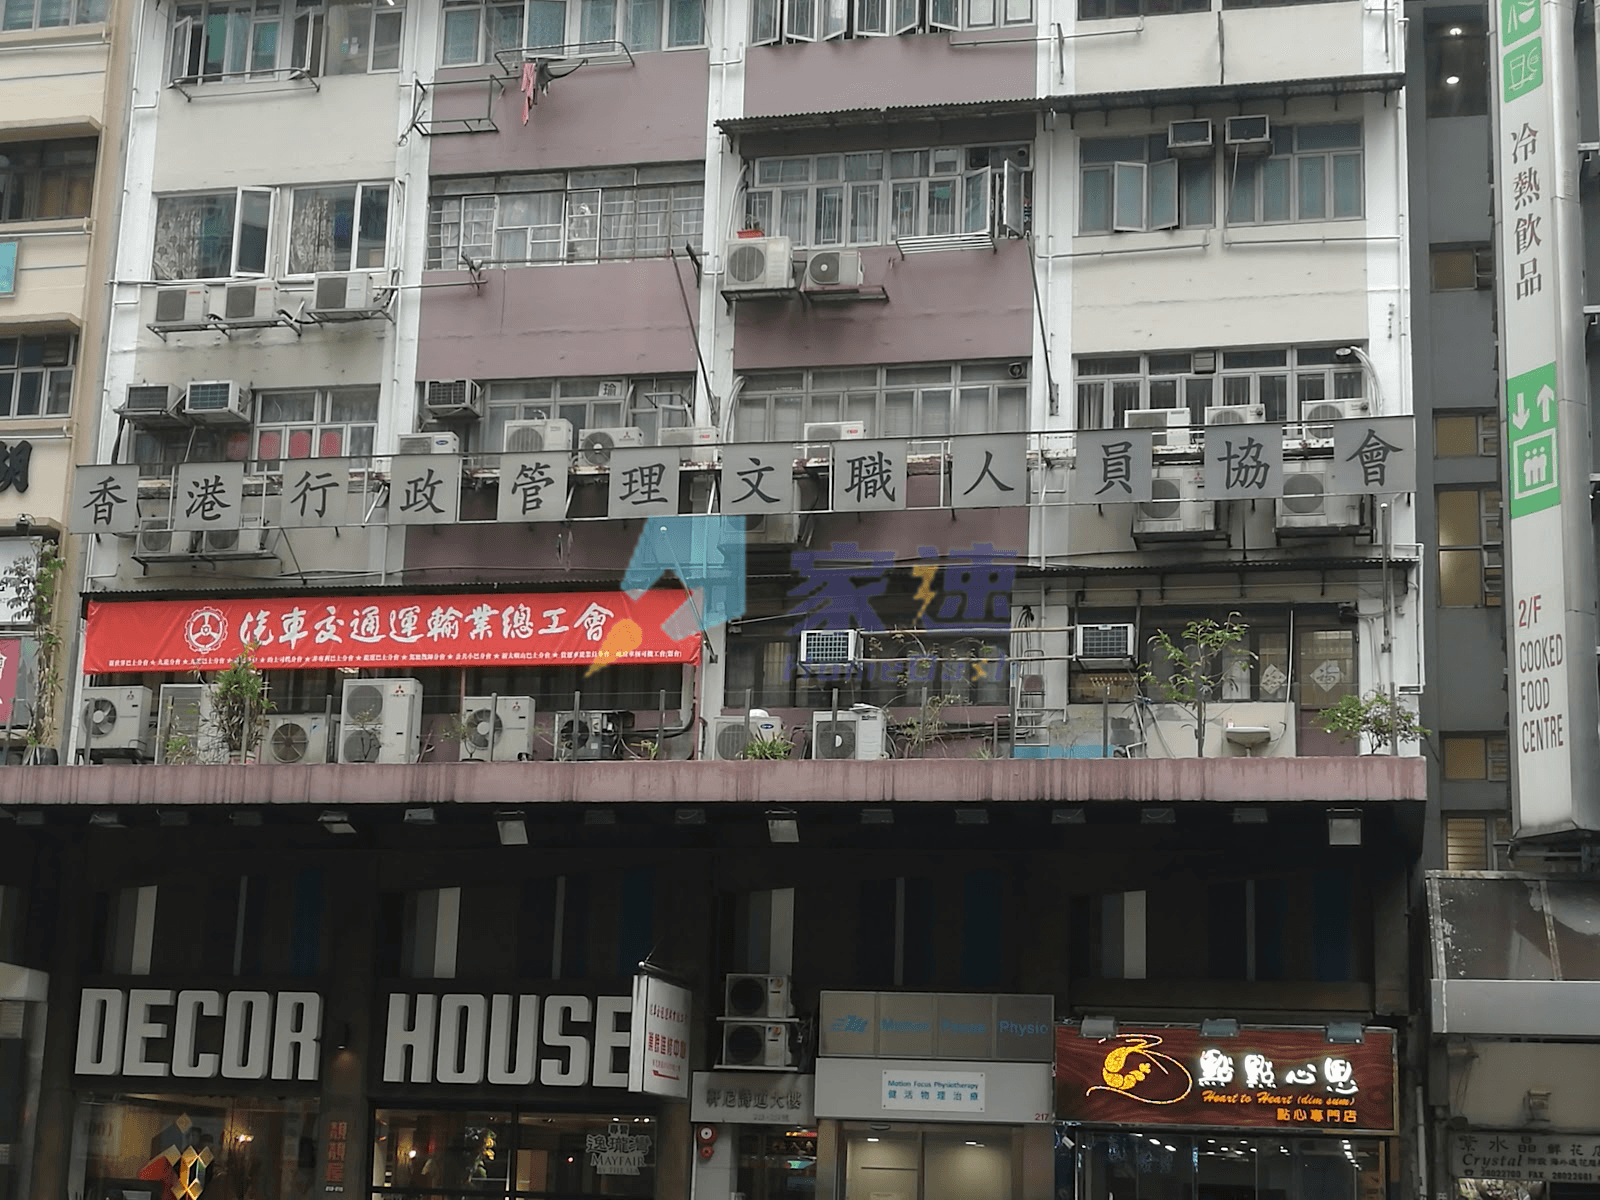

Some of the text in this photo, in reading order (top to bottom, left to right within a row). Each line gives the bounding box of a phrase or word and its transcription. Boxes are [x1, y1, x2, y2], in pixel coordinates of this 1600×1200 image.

[1511, 122, 1541, 300] 冷熱飲品
[82, 428, 1404, 527] 香港行政管理文職人員協會
[1518, 595, 1541, 629] 2/F
[1519, 633, 1563, 673] COOKED
[1520, 677, 1550, 713] FOOD
[1522, 714, 1563, 753] CENTRE
[75, 988, 630, 1088] DECOR HOUSE
[1000, 1020, 1049, 1037] Physio
[1202, 1090, 1238, 1103] Heart
[1240, 1093, 1252, 1104] to
[1257, 1091, 1293, 1104] Heart
[1035, 1113, 1049, 1121] 217
[1277, 1108, 1357, 1122] 點心專門店
[591, 1153, 646, 1167] MAYFAIR
[1462, 1154, 1522, 1171] Crystal
